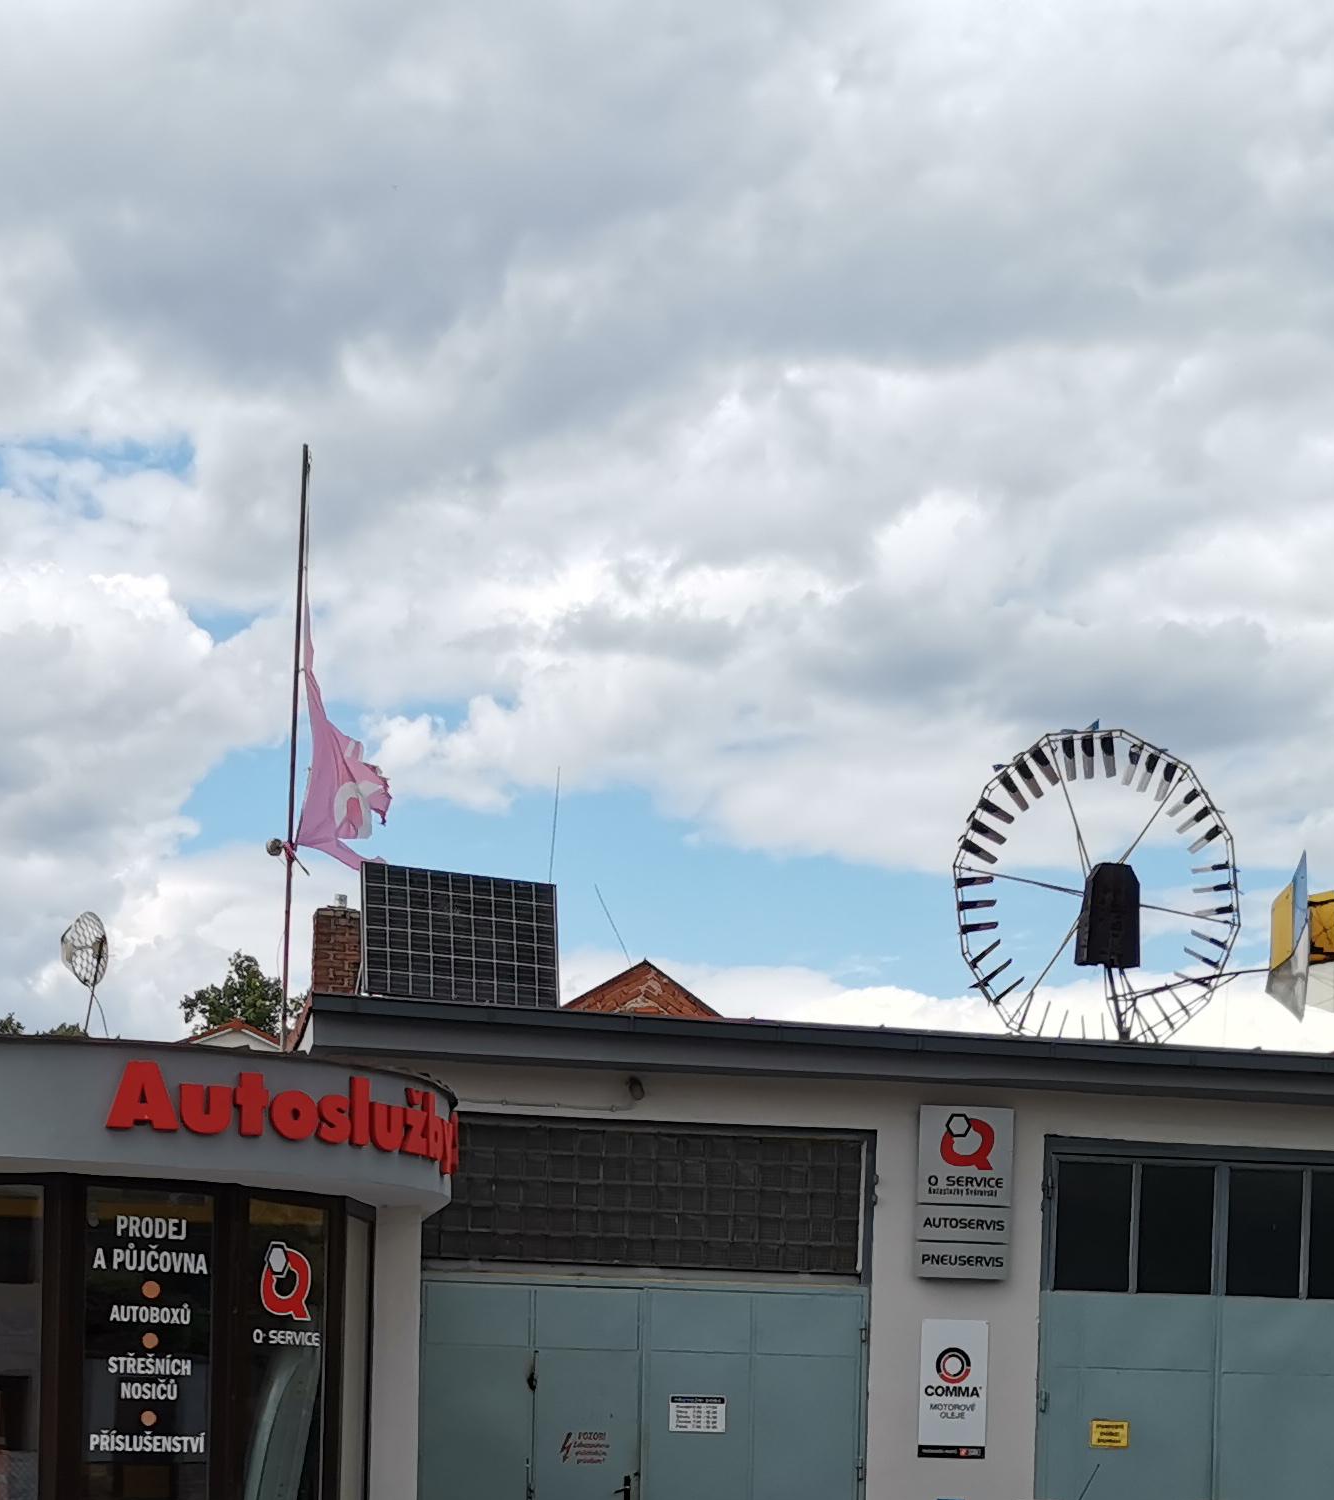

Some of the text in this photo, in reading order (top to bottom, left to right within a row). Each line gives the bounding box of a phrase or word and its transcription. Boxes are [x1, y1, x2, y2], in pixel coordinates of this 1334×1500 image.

[945, 1175, 1004, 1189] SERVICE
[116, 1214, 187, 1240] PRODEJ
[922, 1216, 1006, 1232] AUTOSERVIS
[92, 1242, 208, 1275] A PŮJČOVNA
[921, 1253, 1005, 1268] PNEUSERVIS
[109, 1302, 191, 1325] AUTOBOXŮ
[268, 1329, 321, 1346] SERVICE
[107, 1351, 192, 1376] STŘEŠNÍCH
[120, 1377, 178, 1400] NOSIČŮ
[89, 1429, 206, 1453] PŘÍSLUŠENSTVÍ
